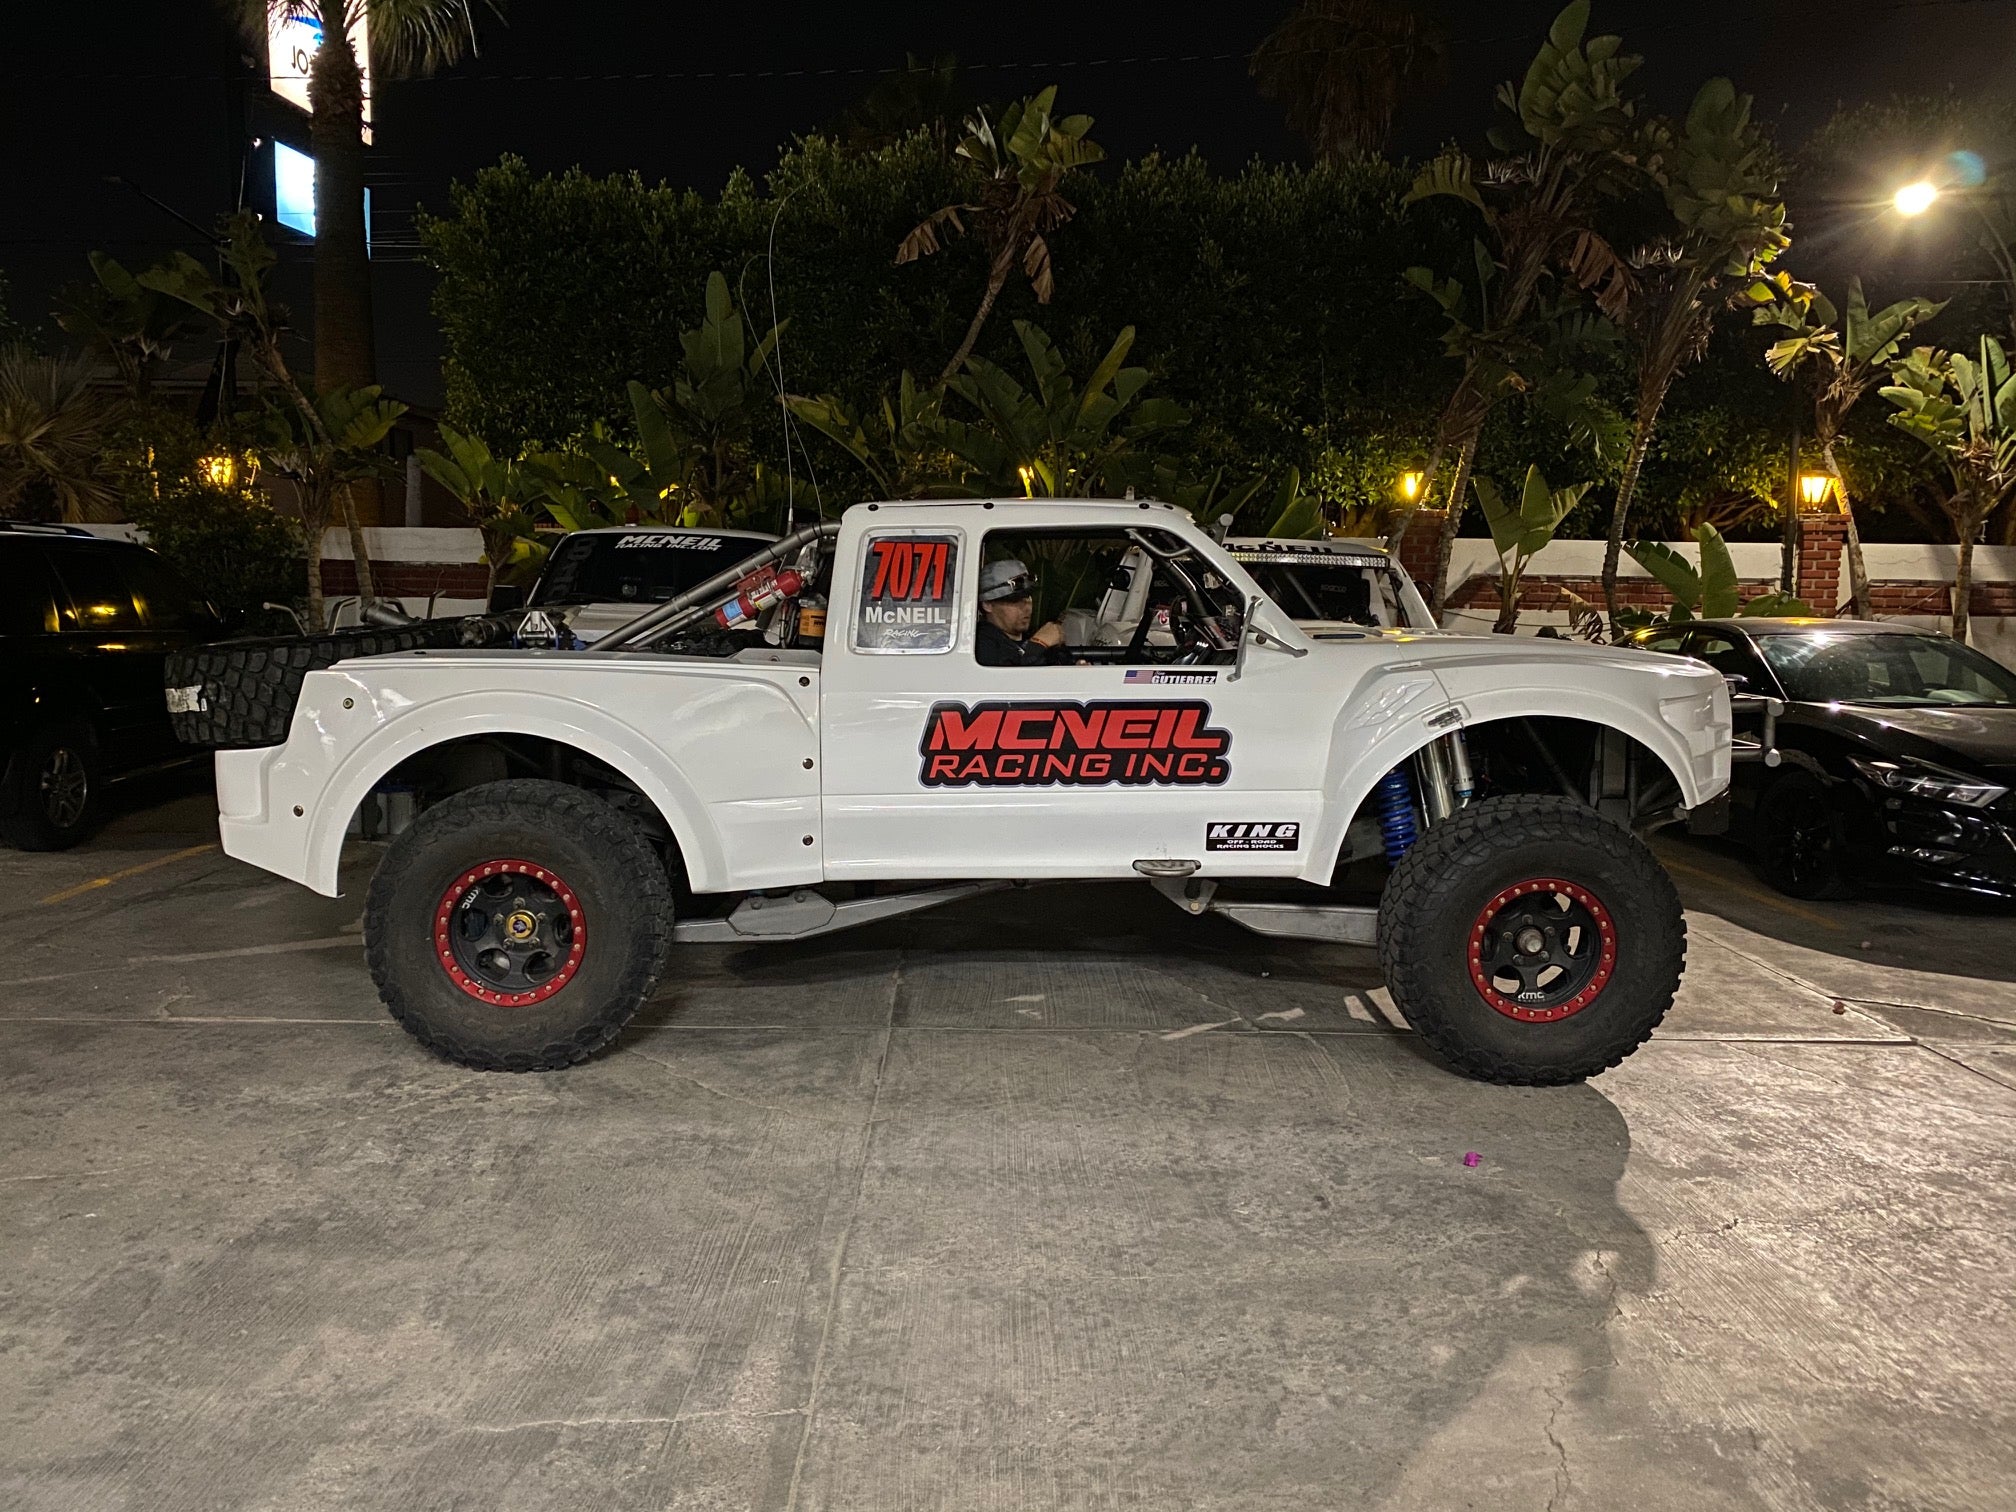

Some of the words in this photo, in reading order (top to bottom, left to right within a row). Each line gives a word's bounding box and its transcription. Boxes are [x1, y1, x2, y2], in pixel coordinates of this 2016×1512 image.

[617, 535, 722, 547] MCNEIL
[870, 542, 949, 601] 7071
[865, 606, 947, 623] McNEIL
[882, 629, 929, 638] RACING
[1151, 675, 1217, 684] GUTIERREZ
[929, 709, 1222, 750] MCNEIL
[929, 753, 1111, 778] RACING
[1125, 753, 1222, 777] INC.
[1209, 824, 1297, 837] KING
